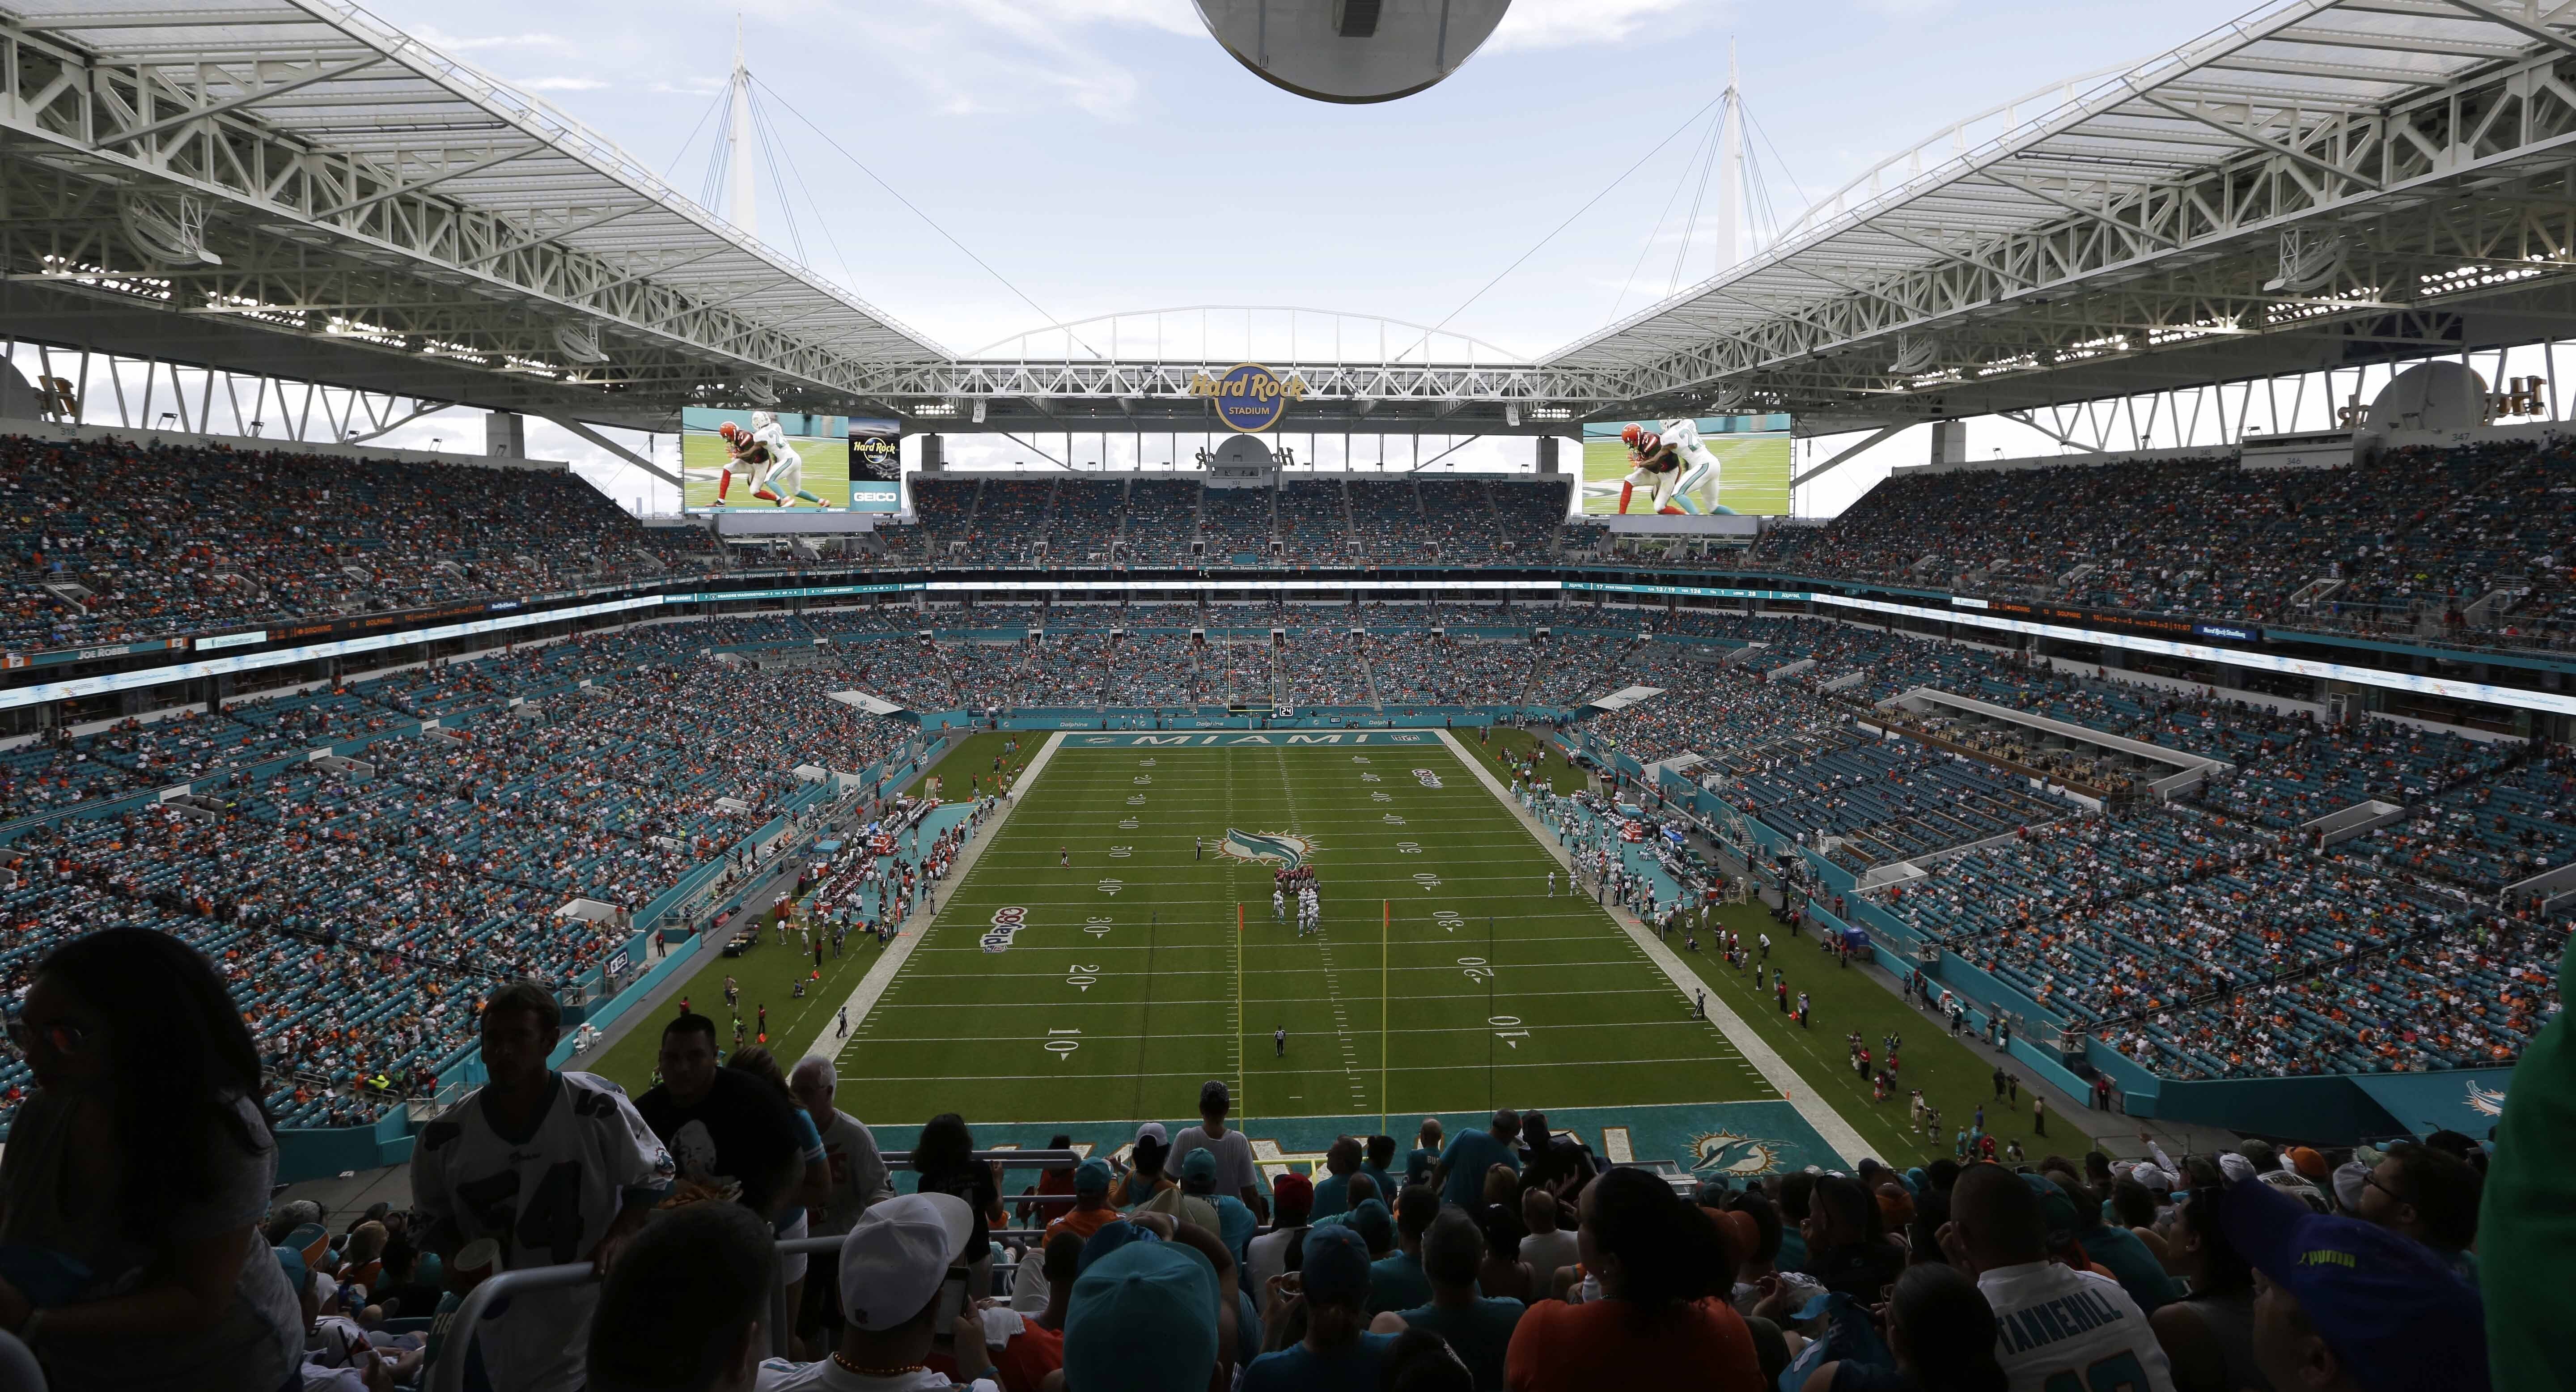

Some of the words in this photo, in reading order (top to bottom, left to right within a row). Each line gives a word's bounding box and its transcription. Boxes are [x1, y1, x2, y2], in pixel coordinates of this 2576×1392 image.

[1190, 374, 1249, 397] Hard
[1250, 374, 1306, 402] Rock
[61, 428, 76, 437] 318
[2451, 433, 2470, 441] 347
[854, 441, 875, 451] Hard
[876, 442, 895, 454] Rock
[854, 492, 896, 501] GEICO
[2057, 611, 2081, 619] DOLPHINS
[77, 650, 96, 660] JOE
[97, 646, 129, 657] ROBBIE
[1131, 734, 1368, 744] MIAMI
[1126, 796, 1146, 805] 30
[1371, 794, 1392, 802] 30
[1119, 819, 1140, 828] 40
[1383, 816, 1406, 825] 40
[1109, 846, 1131, 857] 50
[1396, 842, 1422, 853] 50
[1097, 878, 1123, 891] 40
[1413, 874, 1441, 887] 40
[1084, 917, 1113, 933] 30
[1433, 911, 1464, 927] 30
[1457, 957, 1494, 977] 20
[1067, 964, 1100, 985] 20
[1488, 1016, 1530, 1038] 10
[1045, 1027, 1082, 1052] 10
[2308, 1250, 2356, 1269] PUMA
[1996, 1288, 2124, 1355] TANNEHILL
